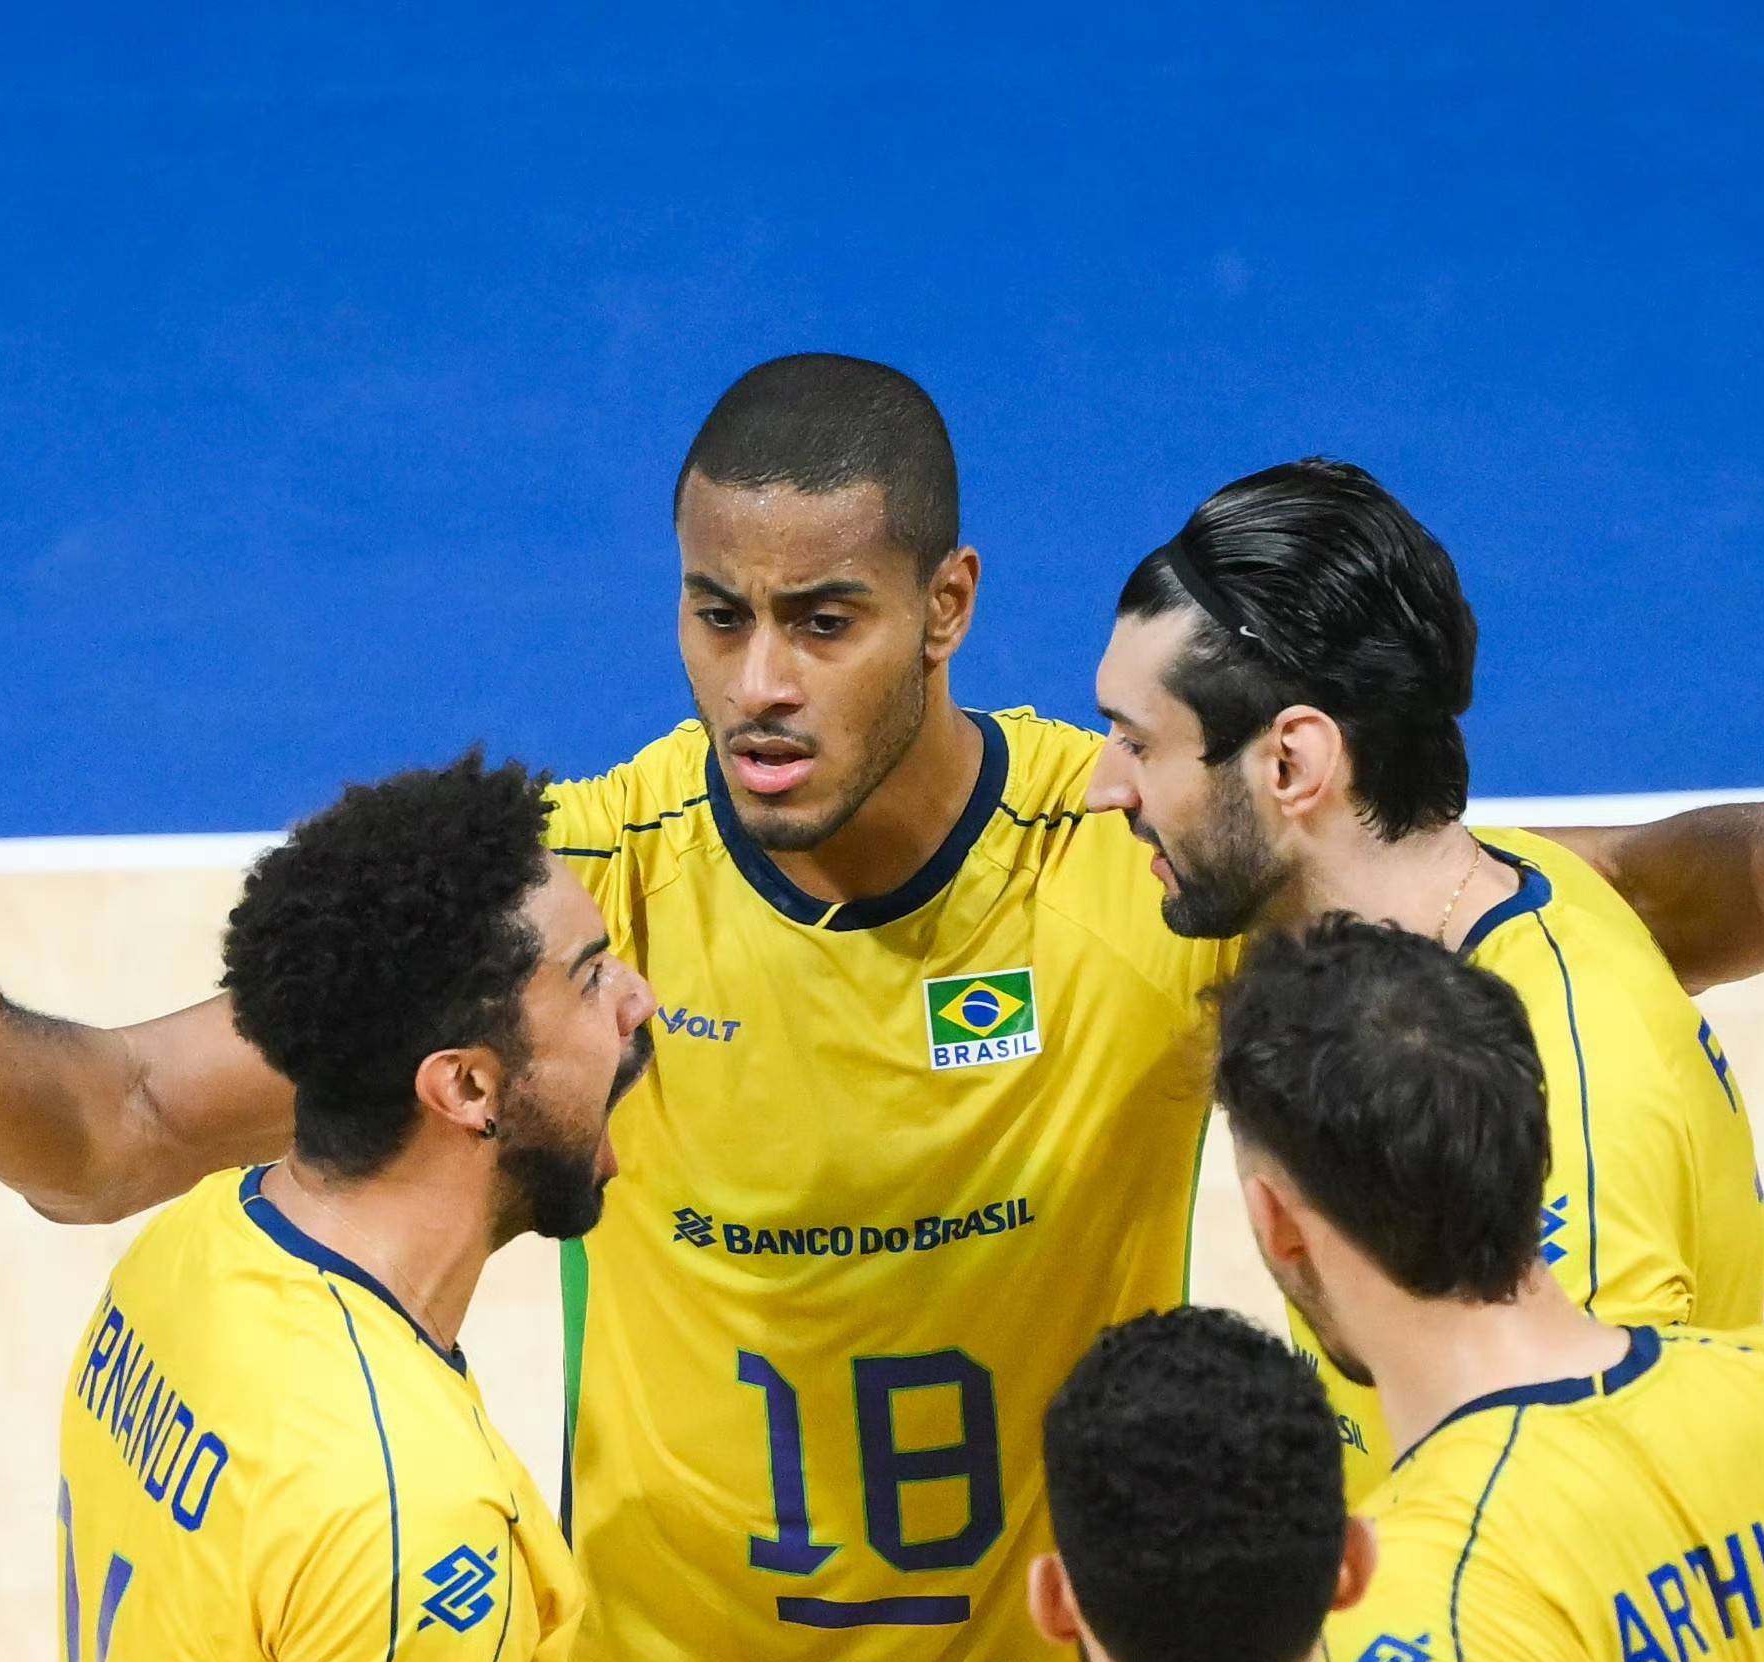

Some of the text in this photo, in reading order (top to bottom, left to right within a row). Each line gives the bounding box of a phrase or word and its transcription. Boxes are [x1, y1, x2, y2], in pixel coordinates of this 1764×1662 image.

[657, 1007, 741, 1042] VOLT
[934, 1034, 1038, 1067] BRASIL
[722, 1197, 1036, 1257] BANCO DO BRASIL
[76, 1284, 230, 1533] RNANDO
[736, 1345, 1006, 1577] 18
